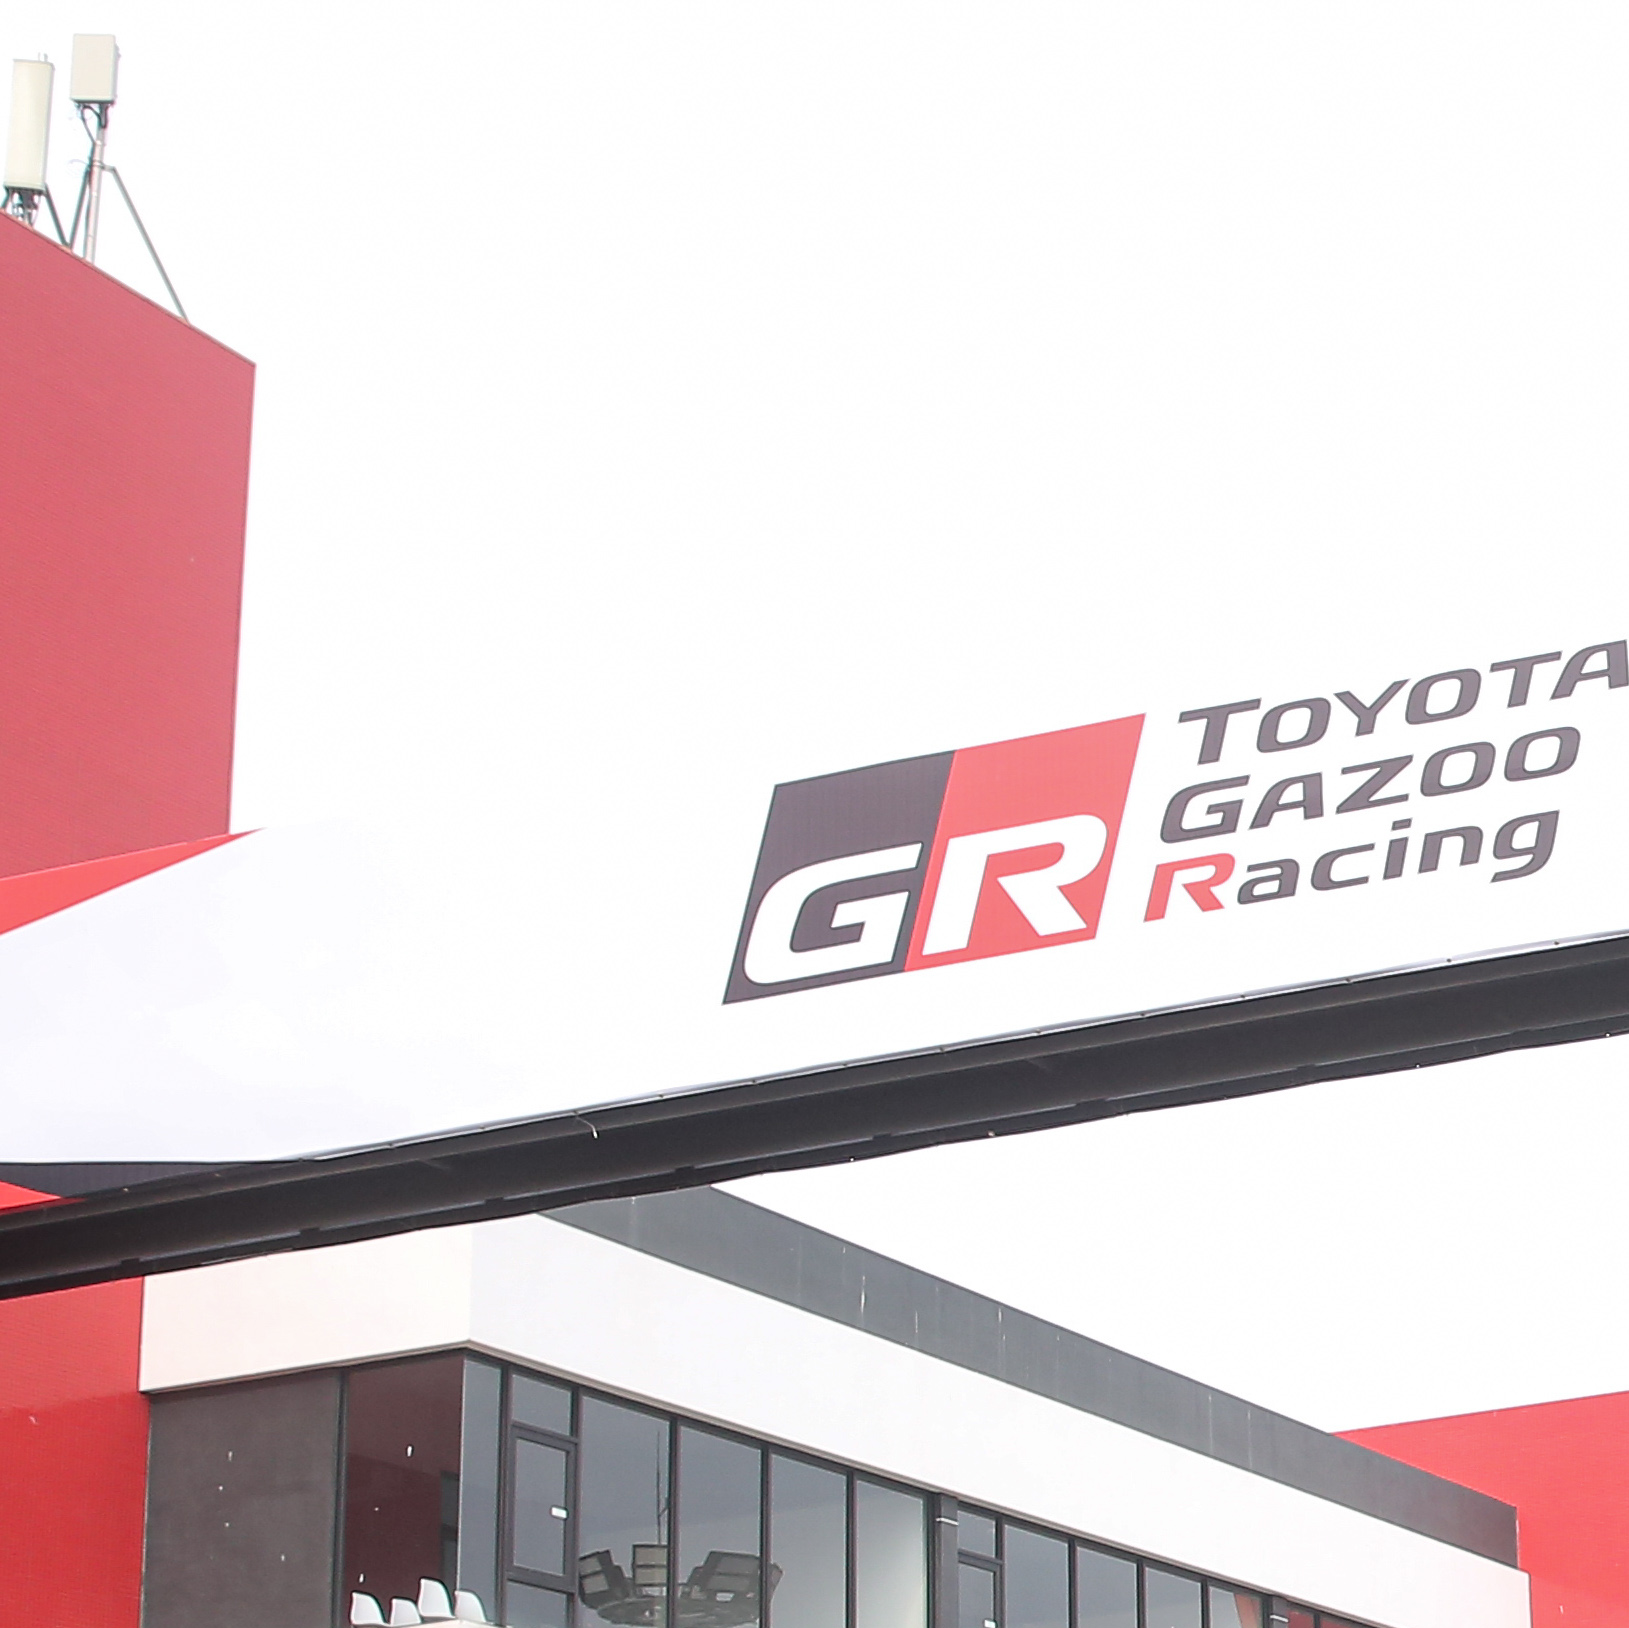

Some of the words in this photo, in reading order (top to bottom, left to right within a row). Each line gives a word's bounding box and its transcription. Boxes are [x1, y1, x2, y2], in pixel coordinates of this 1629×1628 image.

[1176, 639, 1629, 766] TOYOTA
[1159, 726, 1581, 846] GAZOO
[743, 813, 1108, 987] GR
[1143, 809, 1560, 924] Racing
